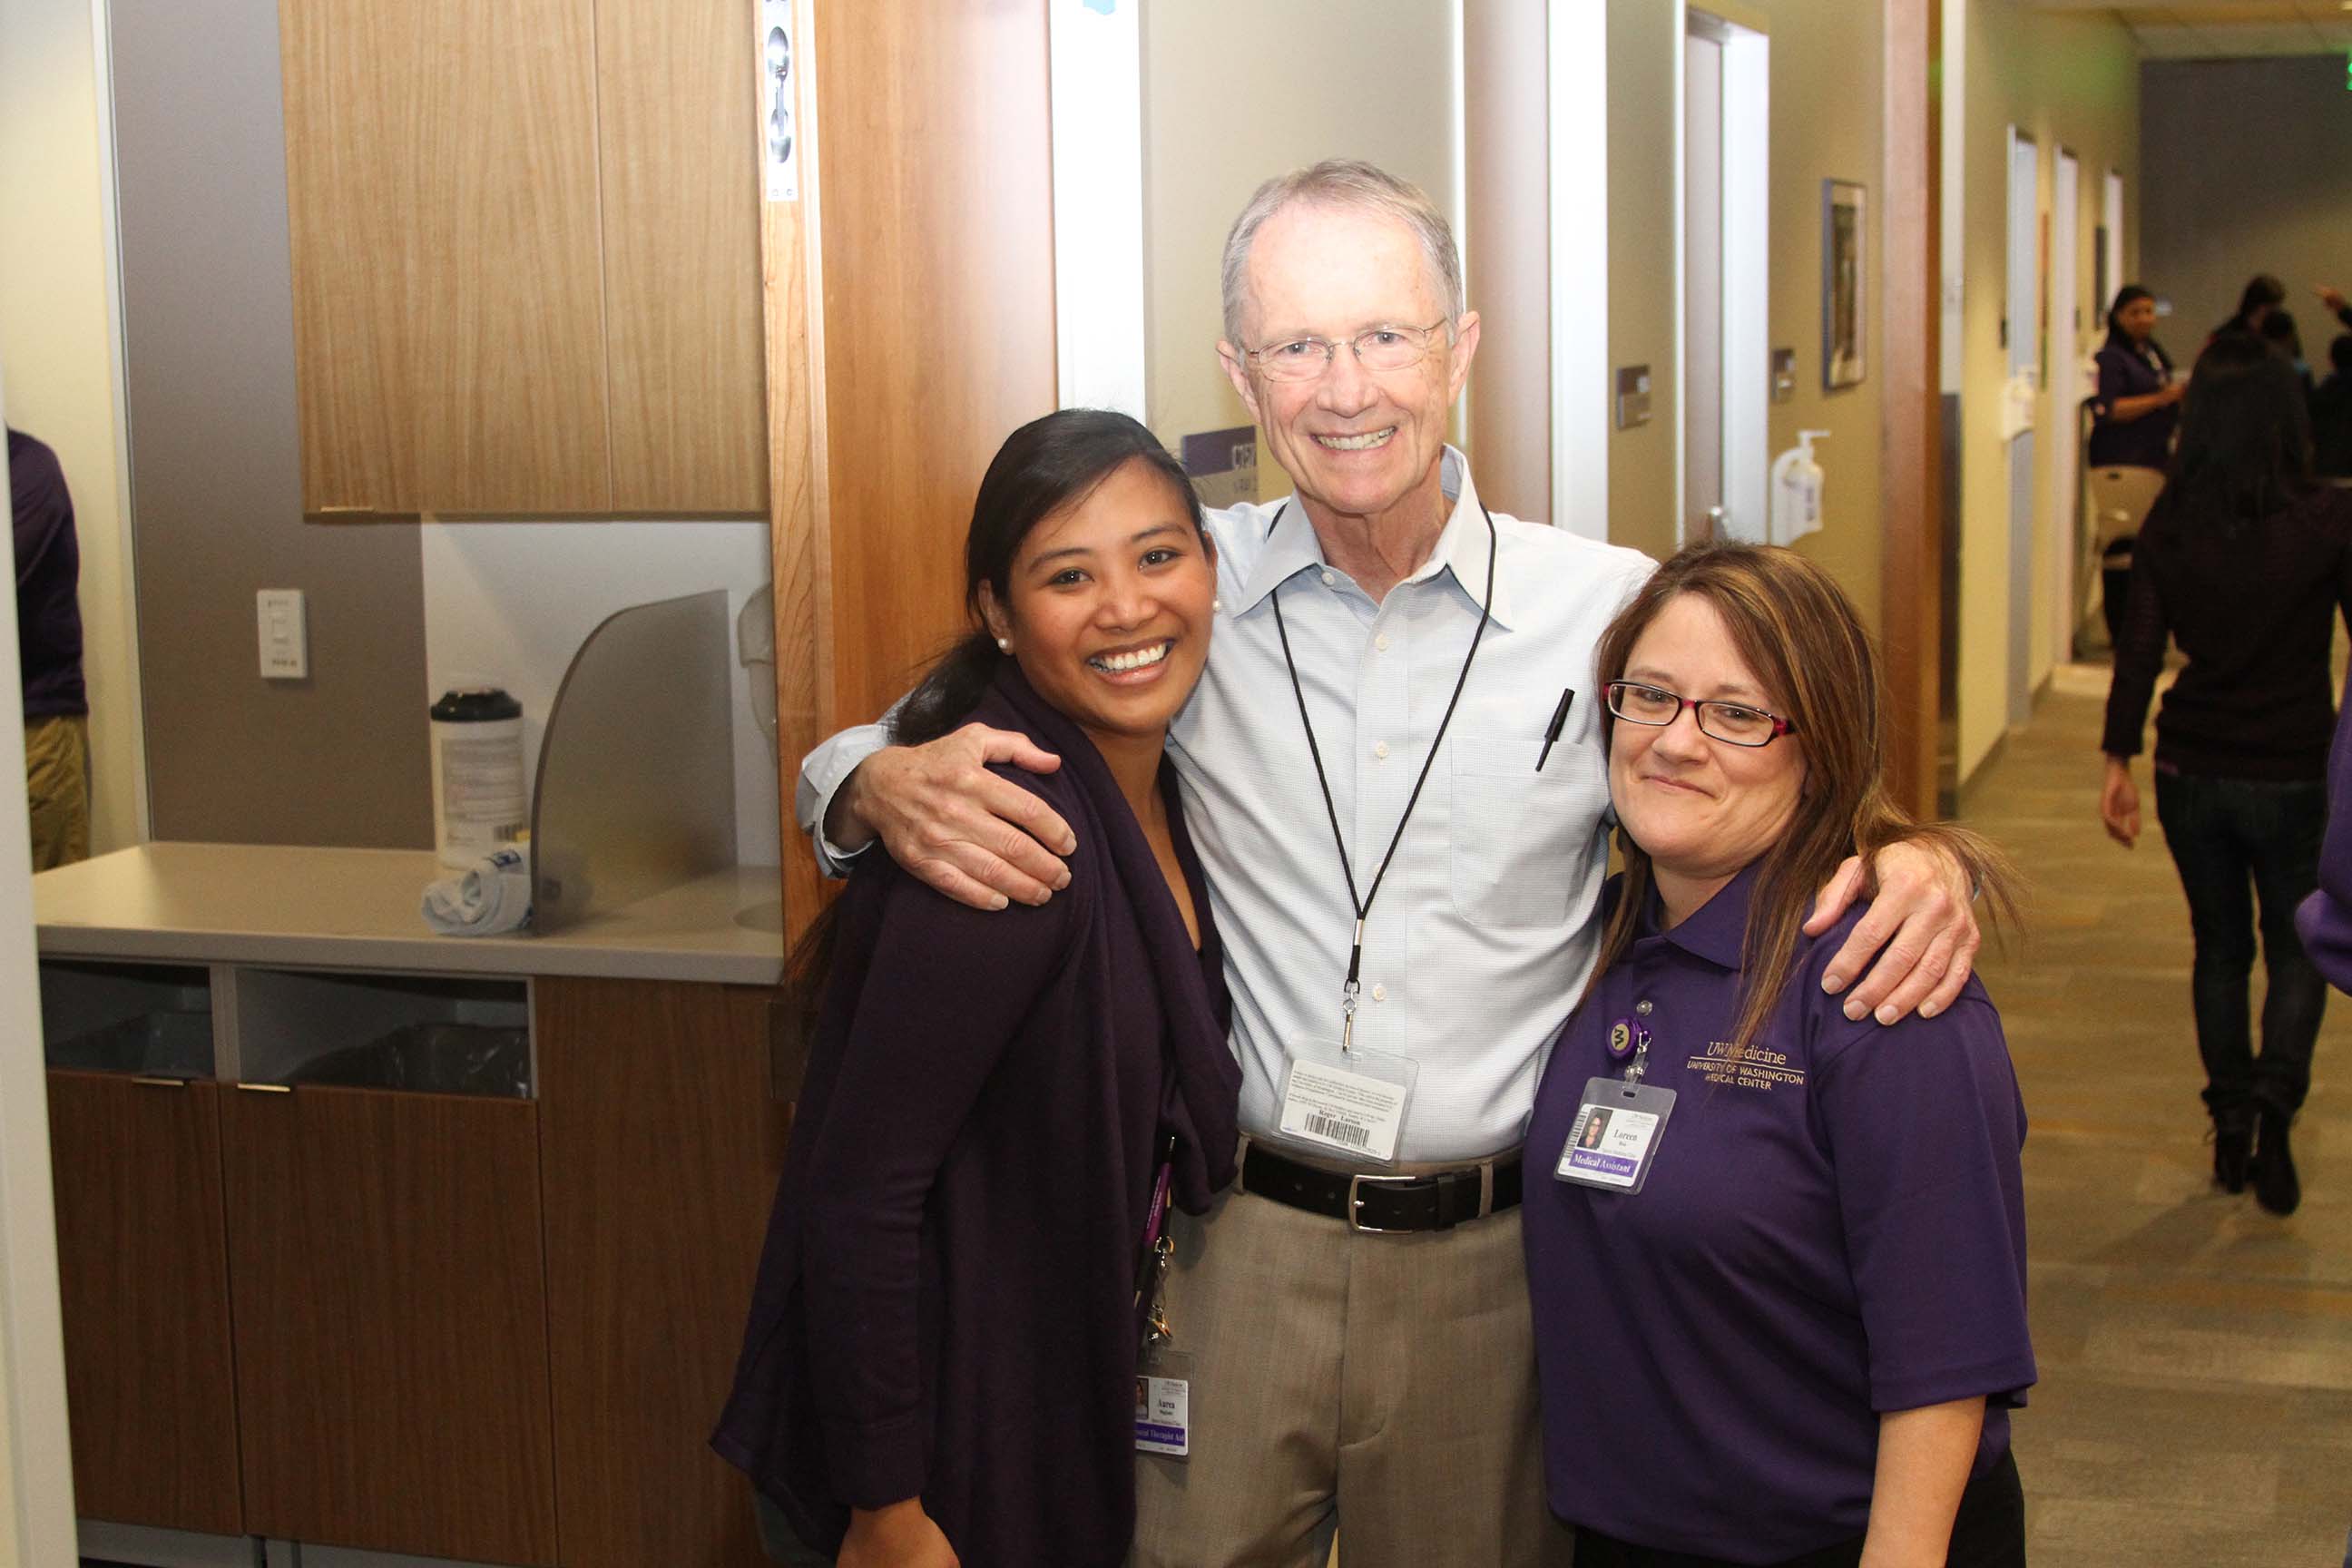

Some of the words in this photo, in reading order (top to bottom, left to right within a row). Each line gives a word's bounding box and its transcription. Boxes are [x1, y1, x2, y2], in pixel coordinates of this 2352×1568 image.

[1726, 1063, 1737, 1074] OF
[1740, 1065, 1804, 1085] WASHINGTON
[1737, 1076, 1772, 1091] CENTER
[1573, 1153, 1601, 1168] Medical
[1600, 1159, 1632, 1173] Assistant
